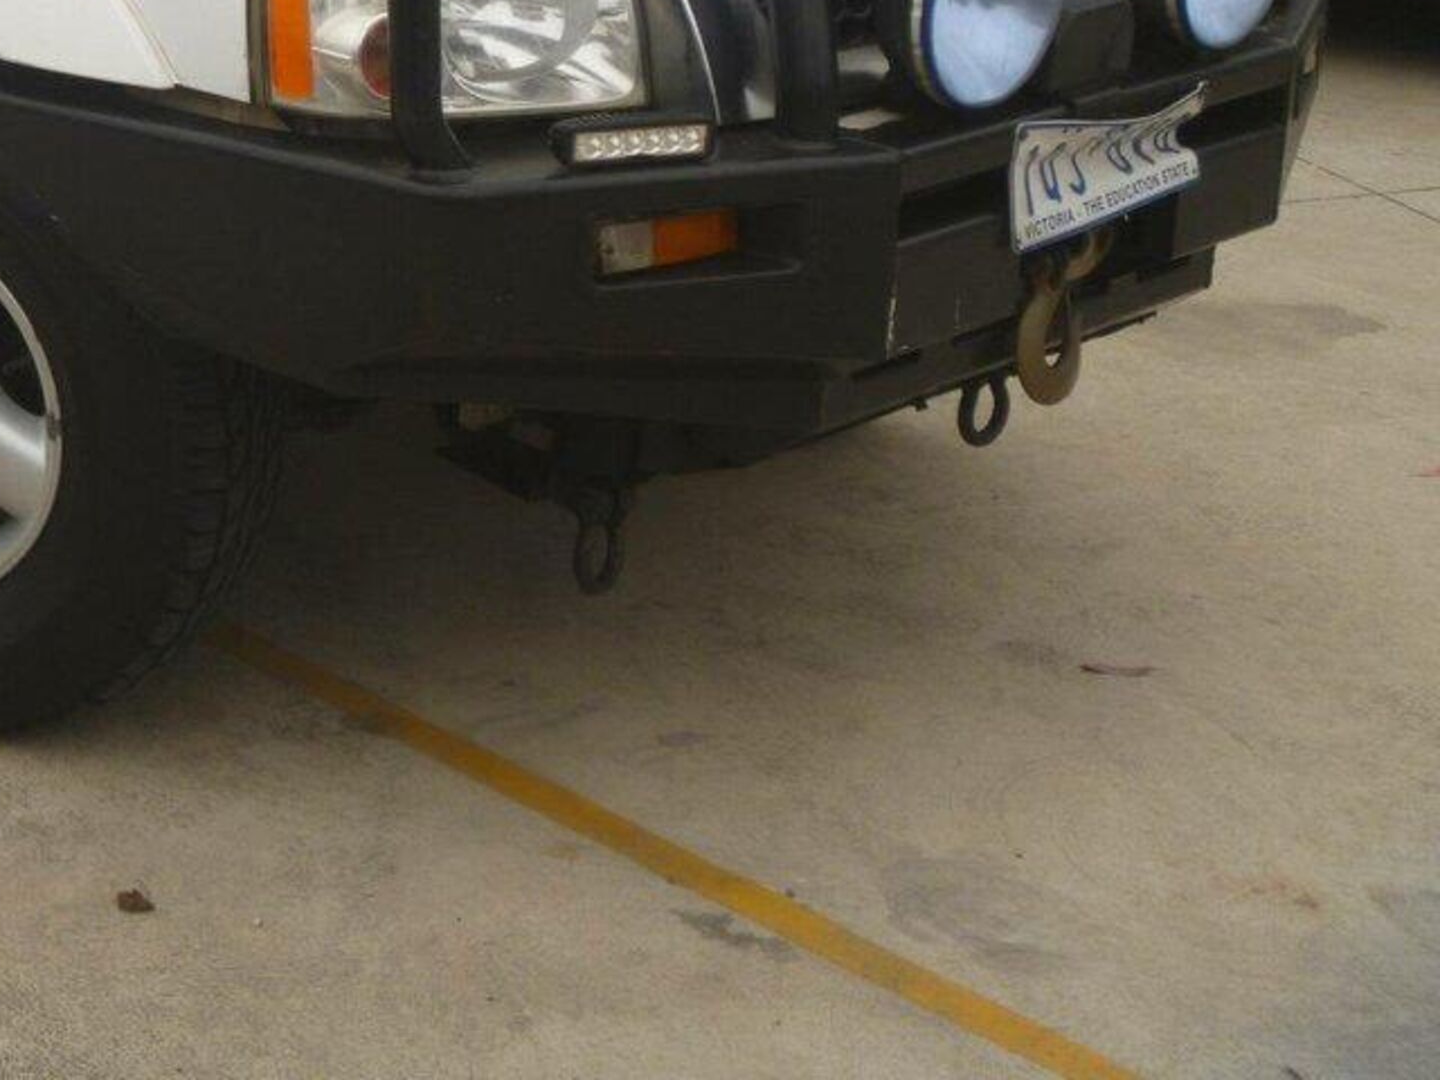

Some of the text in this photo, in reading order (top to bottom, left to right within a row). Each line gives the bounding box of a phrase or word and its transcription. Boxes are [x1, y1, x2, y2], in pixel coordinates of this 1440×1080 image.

[1024, 209, 1076, 239] VICTORIA
[1083, 197, 1106, 217] THE
[1107, 174, 1161, 206] EDUCATION
[1161, 161, 1191, 185] STATE
